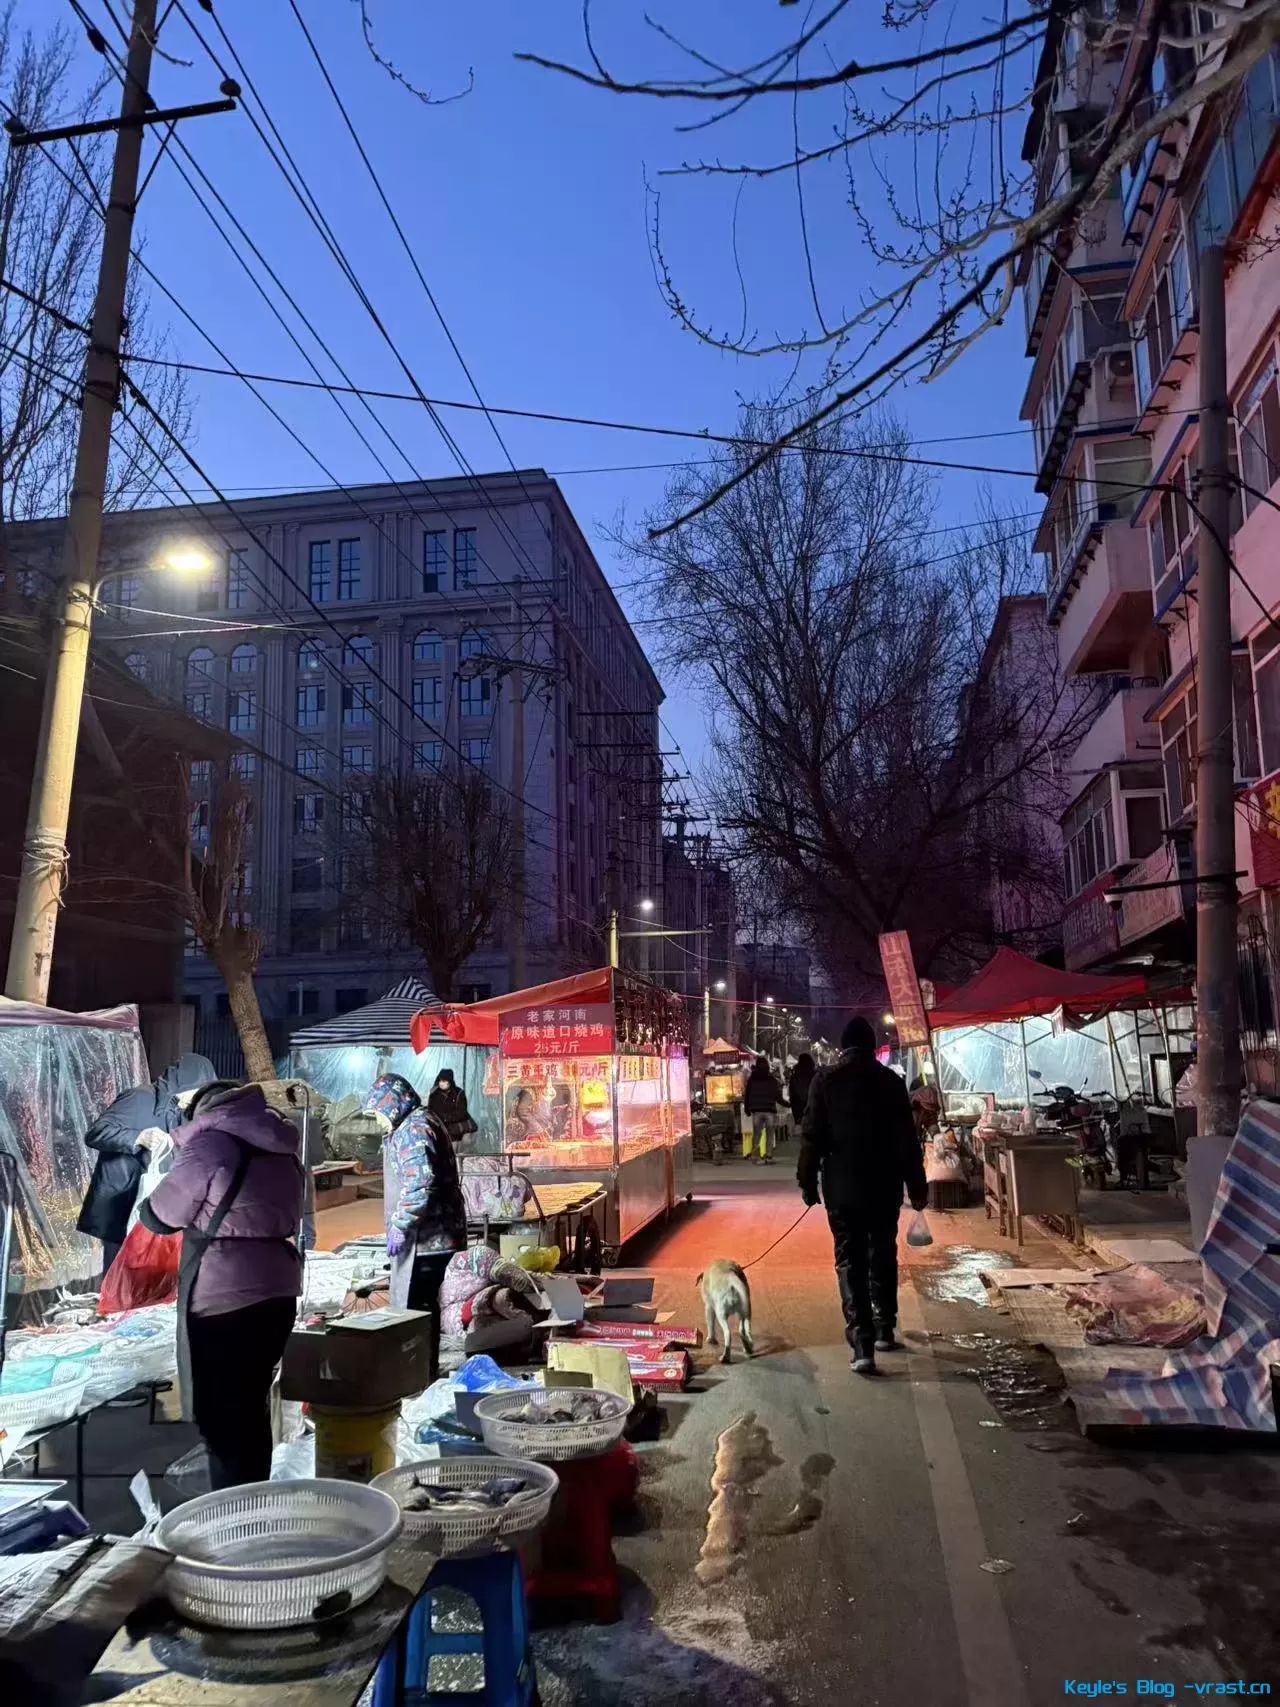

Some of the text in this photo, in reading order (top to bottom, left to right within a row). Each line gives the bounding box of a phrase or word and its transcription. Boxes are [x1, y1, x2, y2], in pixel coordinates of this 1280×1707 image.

[528, 1009, 586, 1022] 老家河南
[511, 1024, 604, 1039] 原味道口烧鸡
